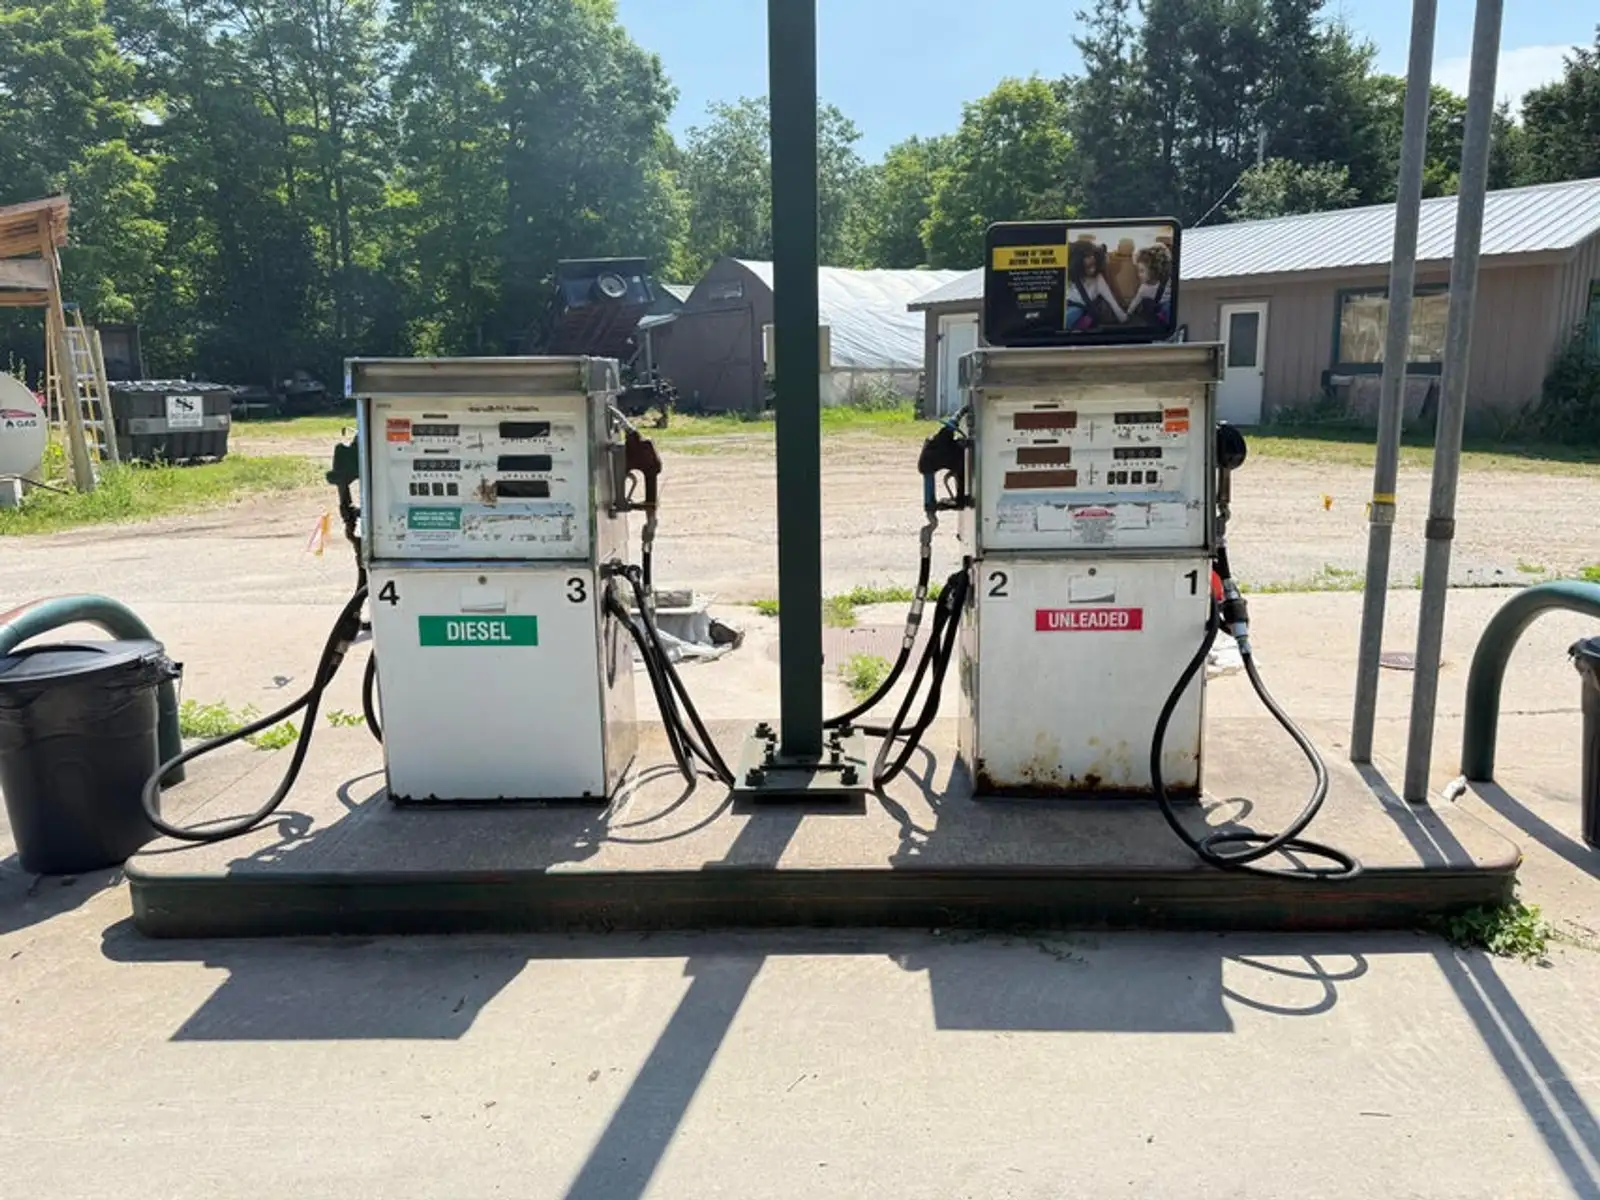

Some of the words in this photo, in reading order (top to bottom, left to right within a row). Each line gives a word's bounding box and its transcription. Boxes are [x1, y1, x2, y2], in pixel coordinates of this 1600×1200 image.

[16, 420, 37, 428] GAS
[378, 580, 400, 606] 4
[566, 577, 587, 603] 3
[988, 571, 1009, 597] 2
[1184, 569, 1199, 596] 1
[446, 621, 511, 641] DIESEL
[1048, 611, 1129, 628] UNLEADED
